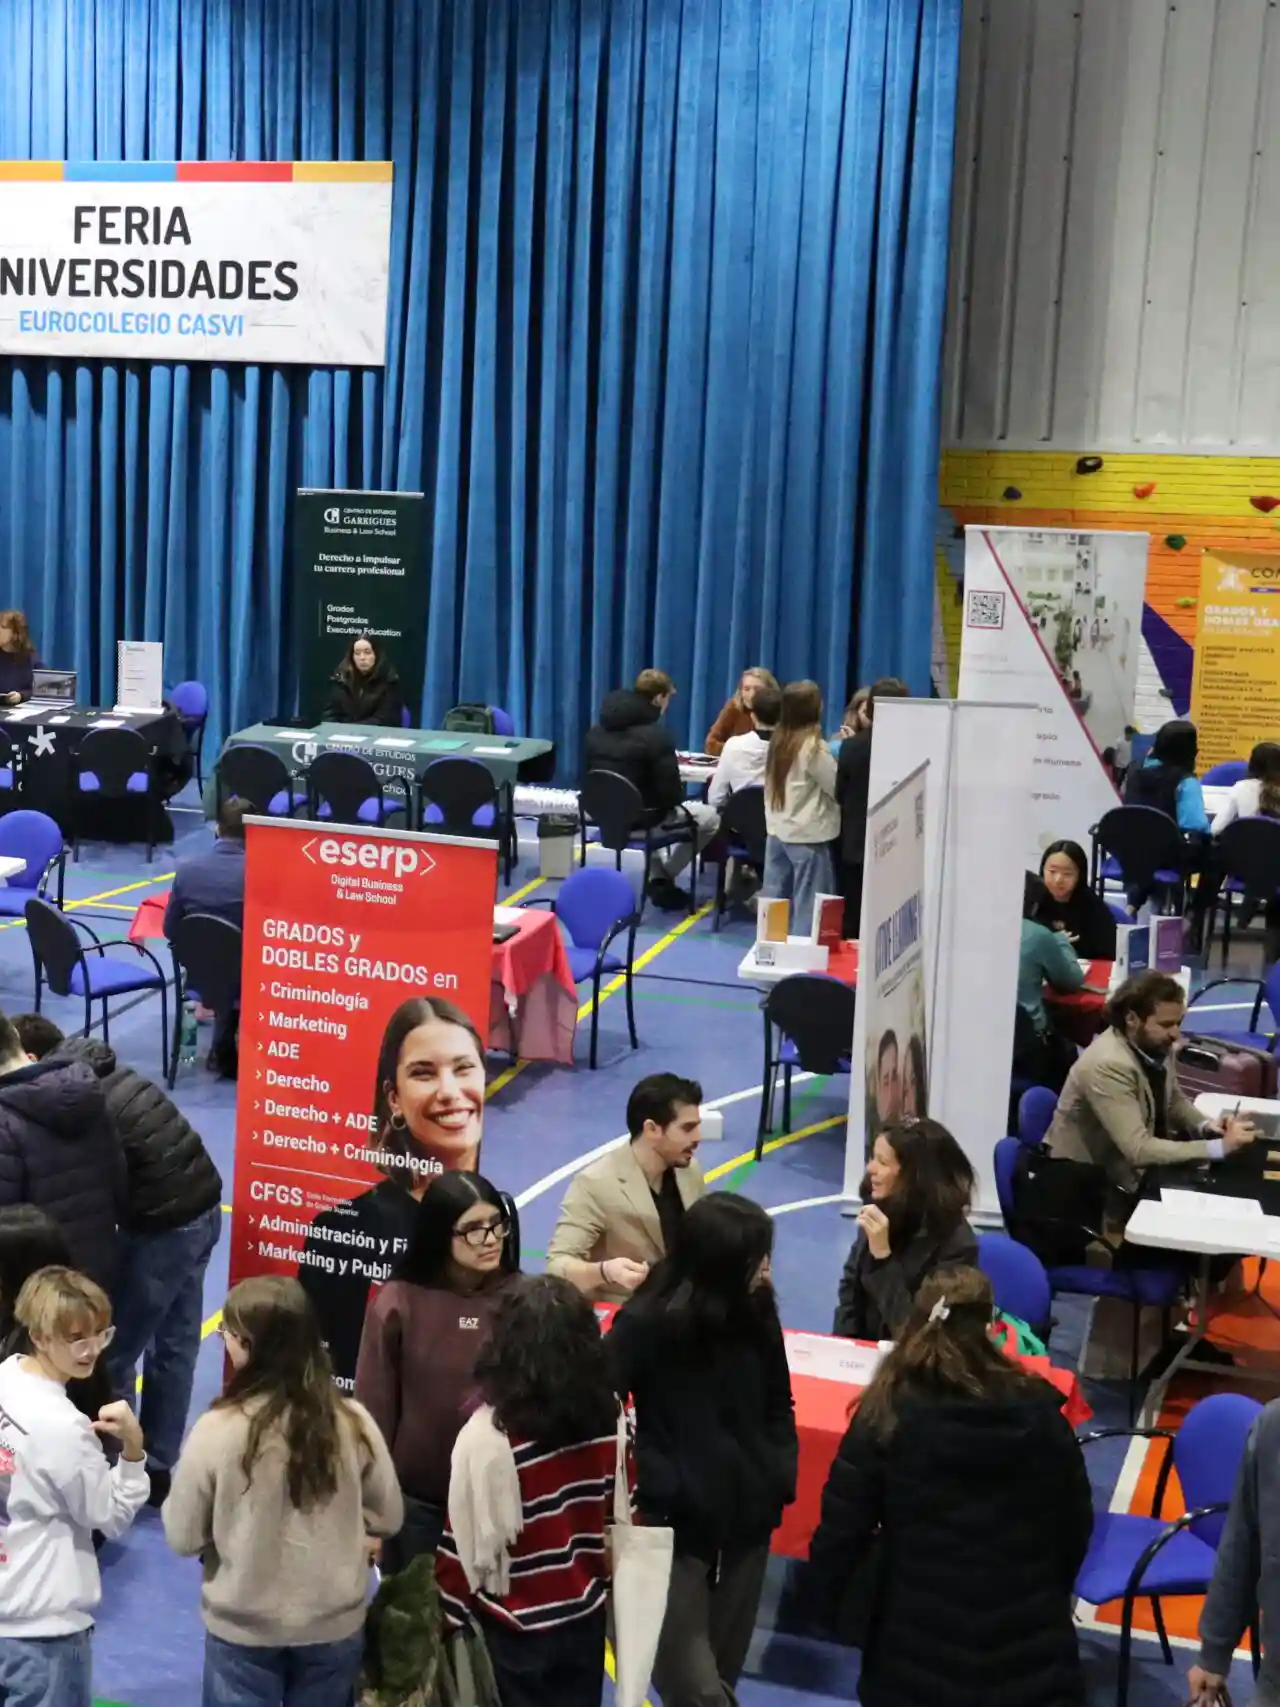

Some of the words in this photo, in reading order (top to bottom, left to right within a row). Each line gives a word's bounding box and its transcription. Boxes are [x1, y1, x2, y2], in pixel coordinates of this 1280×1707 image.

[74, 206, 192, 246] FERIA
[19, 310, 171, 335] EUROCOLEGIO
[177, 313, 244, 337] CASVI
[324, 526, 352, 534] Business
[374, 528, 396, 536] School
[343, 516, 397, 526] GARRIGUES
[314, 564, 323, 572] tu
[324, 565, 356, 574] carrera
[357, 565, 405, 576] profesional
[318, 553, 354, 562] Derecho
[363, 554, 401, 565] impulsar
[326, 604, 355, 613] Grados
[326, 614, 369, 625] Postgrados
[326, 625, 362, 634] Executive
[363, 627, 401, 637] Education
[375, 750, 417, 762] ESTUDIOS
[319, 838, 418, 877] eserp
[331, 874, 360, 888] Digital
[362, 877, 404, 892] Business
[336, 888, 344, 899] &
[345, 889, 364, 901] Law
[365, 891, 397, 905] School
[263, 918, 345, 946] GRADOS
[349, 934, 361, 953] y
[261, 945, 339, 974] DOBLES
[344, 956, 428, 986] GRADOS
[433, 971, 458, 989] en
[270, 981, 369, 1011] Criminología
[269, 1010, 348, 1040] Marketing
[267, 1040, 300, 1060] ADE
[266, 1069, 330, 1093] Derecho
[264, 1098, 328, 1123] Derecho
[332, 1114, 341, 1124] +
[345, 1114, 378, 1132] ADE
[263, 1129, 326, 1154] Derecho
[330, 1144, 340, 1155] +
[344, 1144, 444, 1175] Criminología
[250, 1180, 304, 1207] CFGS
[334, 1206, 359, 1217] Superior
[259, 1213, 375, 1250] Administración
[379, 1239, 389, 1255] y
[258, 1240, 335, 1274] Marketing
[339, 1259, 348, 1275] y
[352, 1258, 392, 1280] Publi
